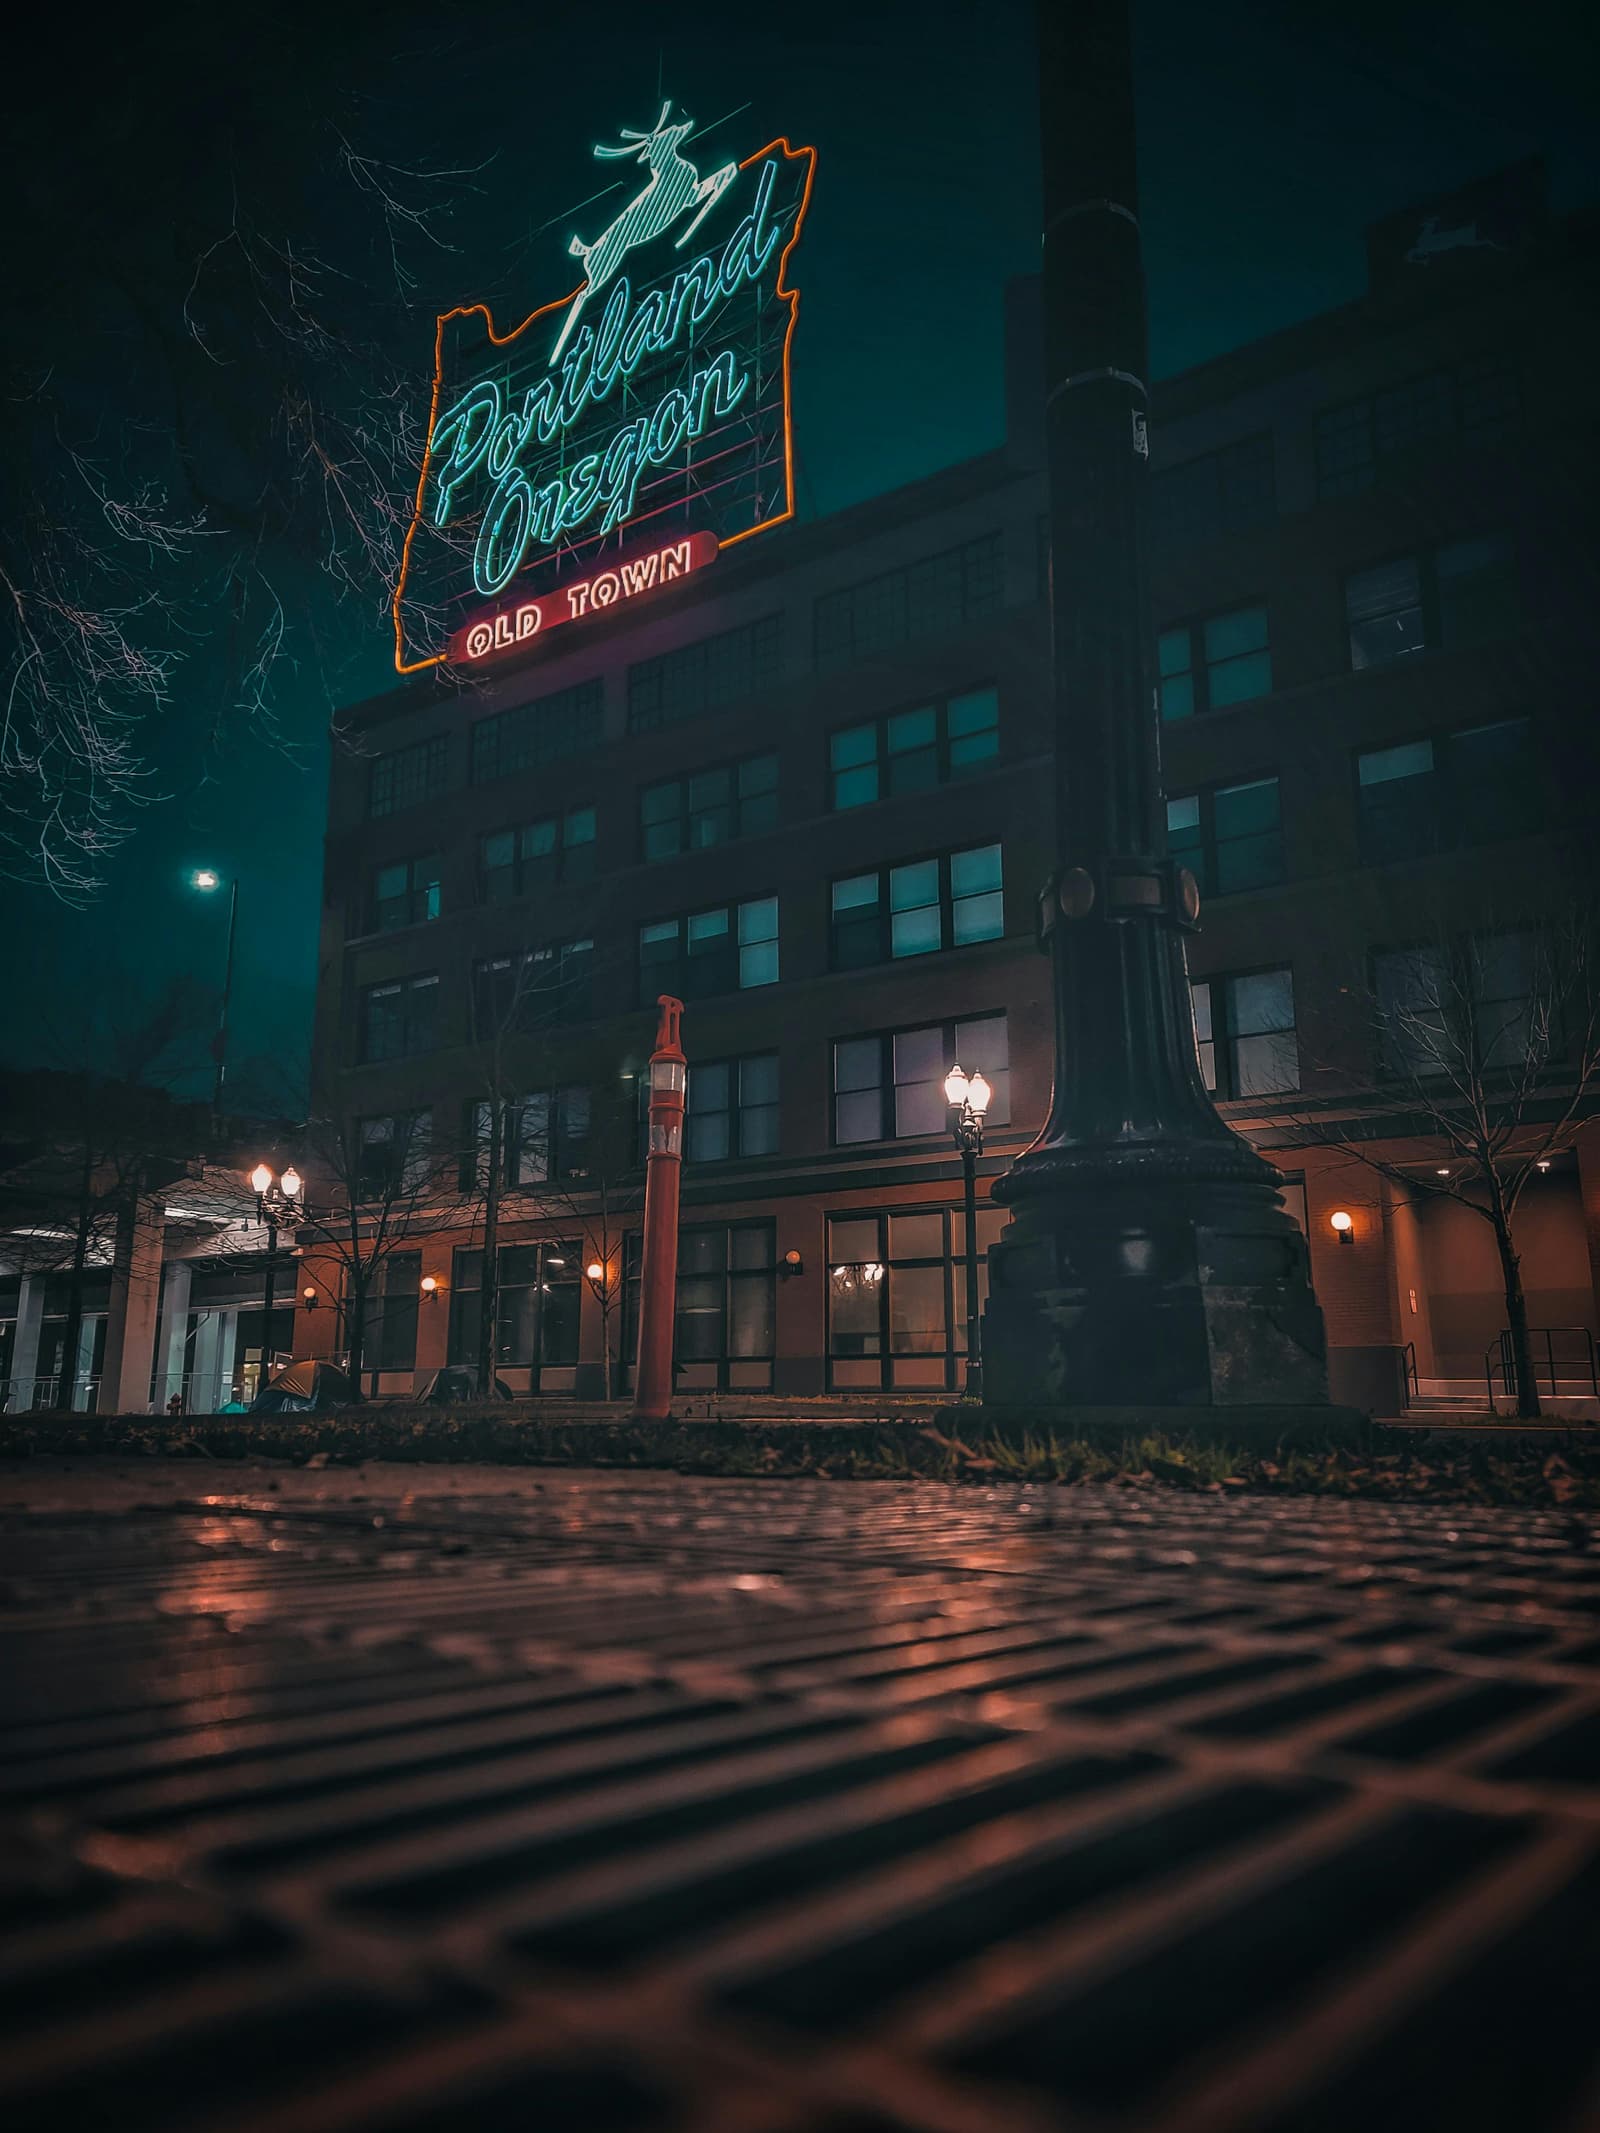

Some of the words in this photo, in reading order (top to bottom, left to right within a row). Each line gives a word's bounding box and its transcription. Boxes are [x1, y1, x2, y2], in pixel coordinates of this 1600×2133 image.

[430, 160, 779, 527] Portland
[473, 350, 748, 595] Oregon
[467, 604, 541, 658] OLD
[567, 541, 692, 619] TOWN
